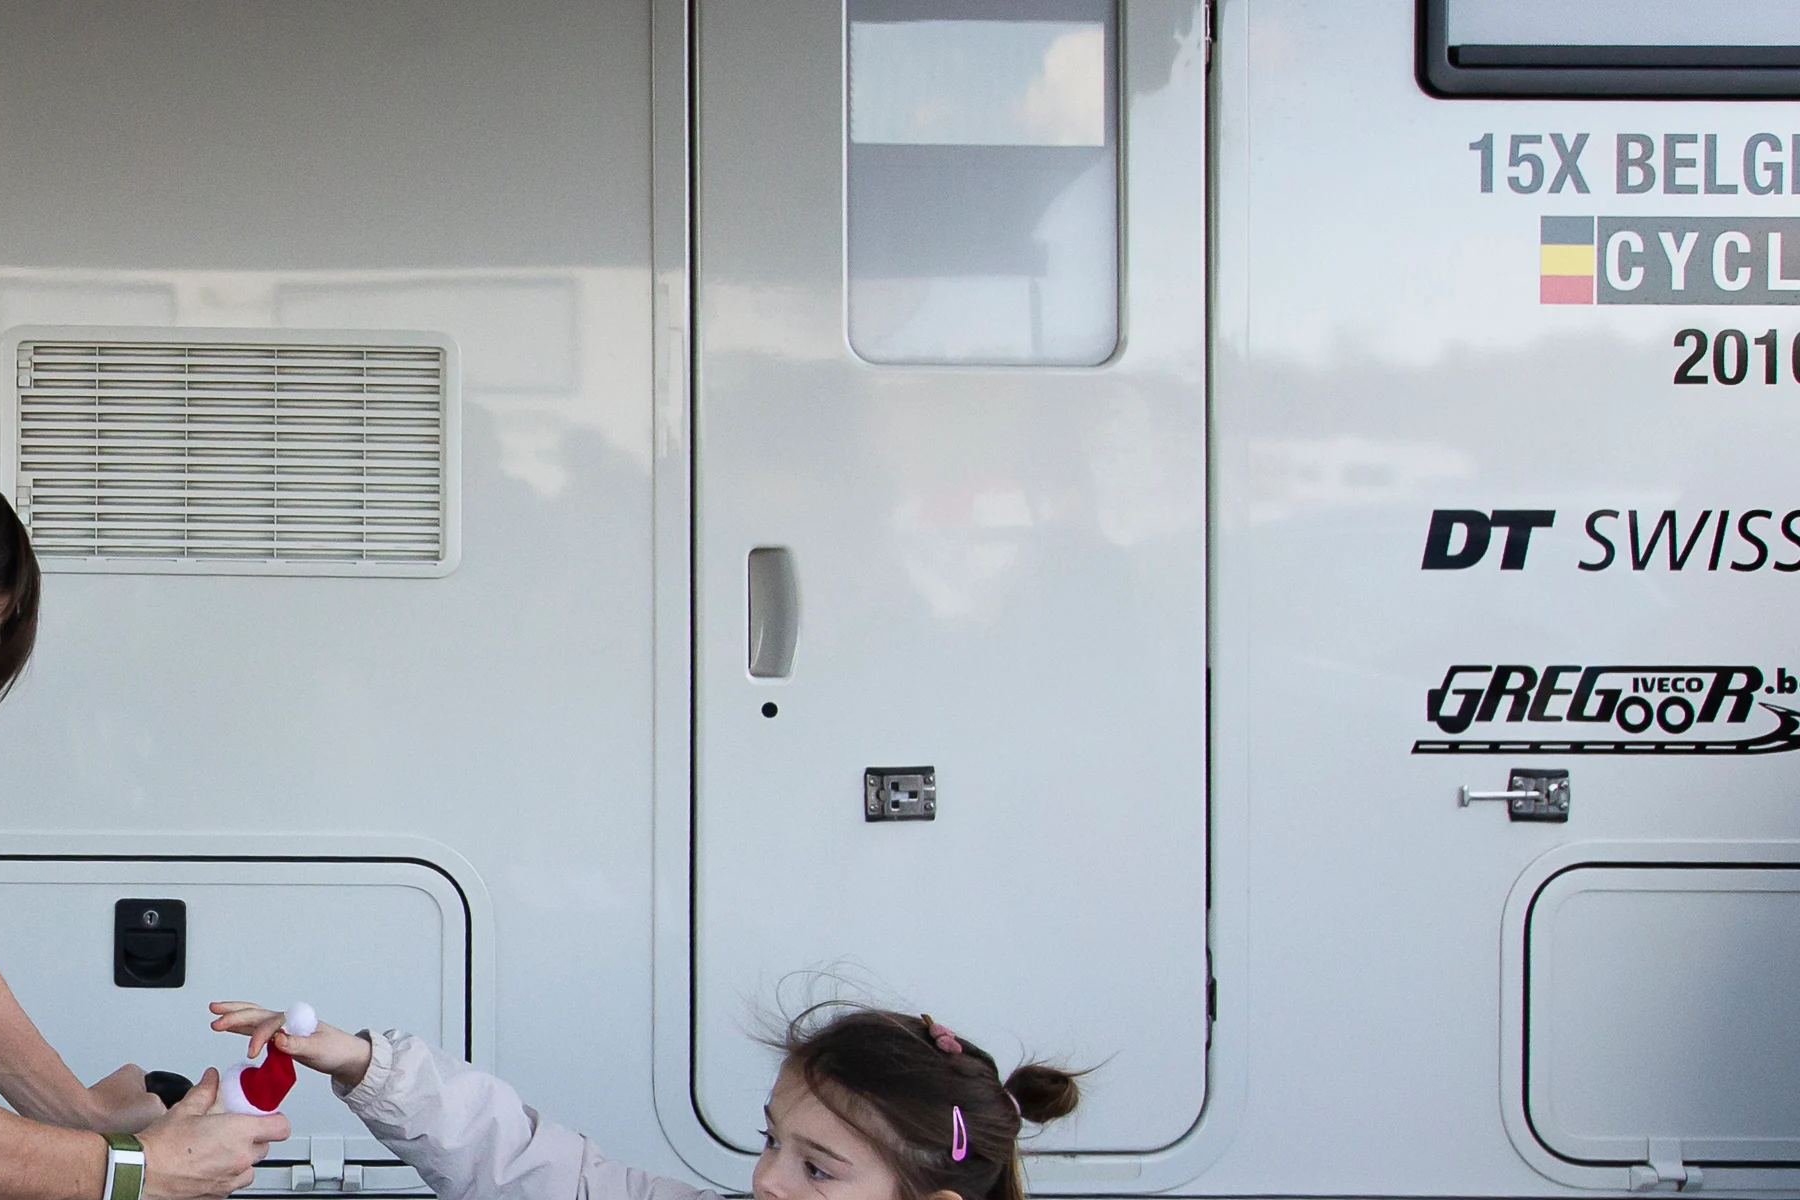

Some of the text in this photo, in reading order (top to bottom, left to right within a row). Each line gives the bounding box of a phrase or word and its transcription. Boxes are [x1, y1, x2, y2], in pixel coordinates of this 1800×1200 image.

[1468, 133, 1591, 194] 15X
[1605, 231, 1800, 291] CYCL
[1672, 329, 1800, 386] 201
[1421, 508, 1800, 572] DT SWISS
[1632, 677, 1704, 693] IVECO
